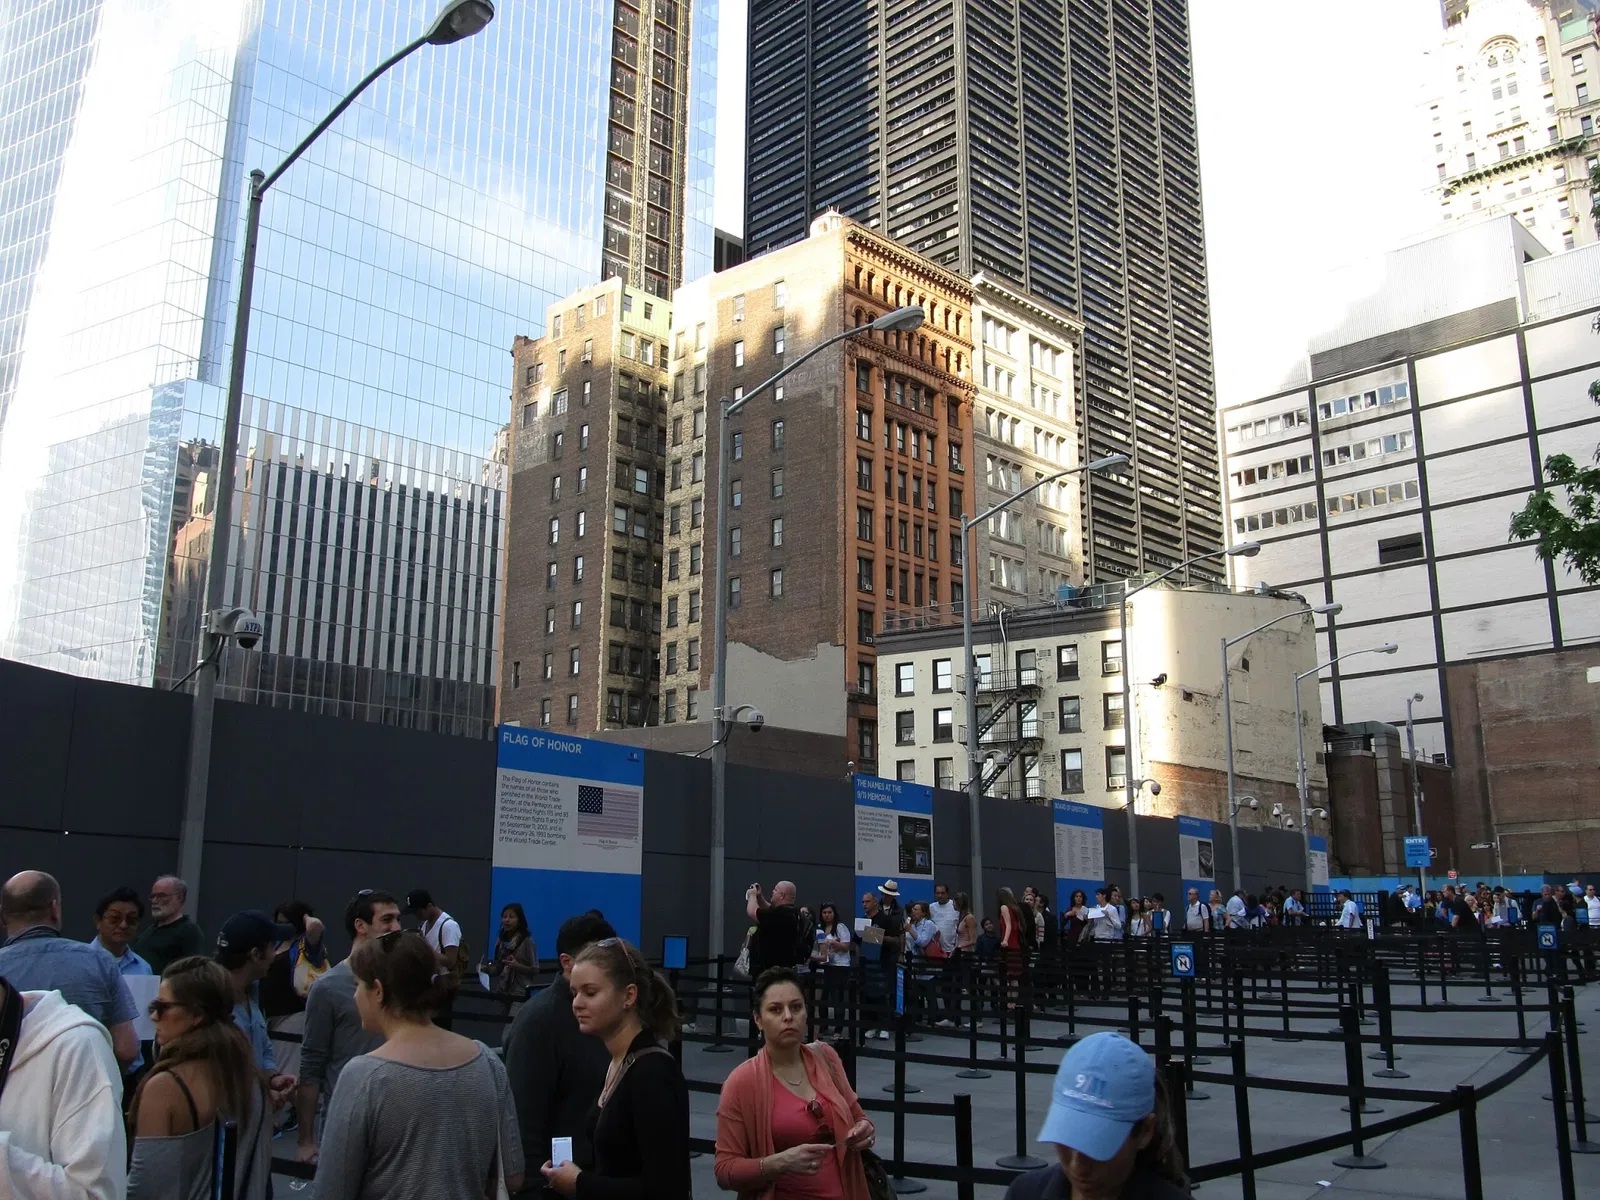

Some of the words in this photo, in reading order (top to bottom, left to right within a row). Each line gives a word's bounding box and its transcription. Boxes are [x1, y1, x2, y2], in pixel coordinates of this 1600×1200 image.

[244, 622, 261, 632] NYPD
[503, 732, 529, 746] FLAG
[531, 737, 546, 748] OF
[547, 740, 582, 754] HONOR
[857, 779, 867, 787] THE
[867, 780, 885, 791] NAMES
[885, 784, 891, 792] AT
[892, 785, 902, 793] THE
[857, 791, 866, 799] 9/11
[867, 792, 893, 803] MEMORIAL
